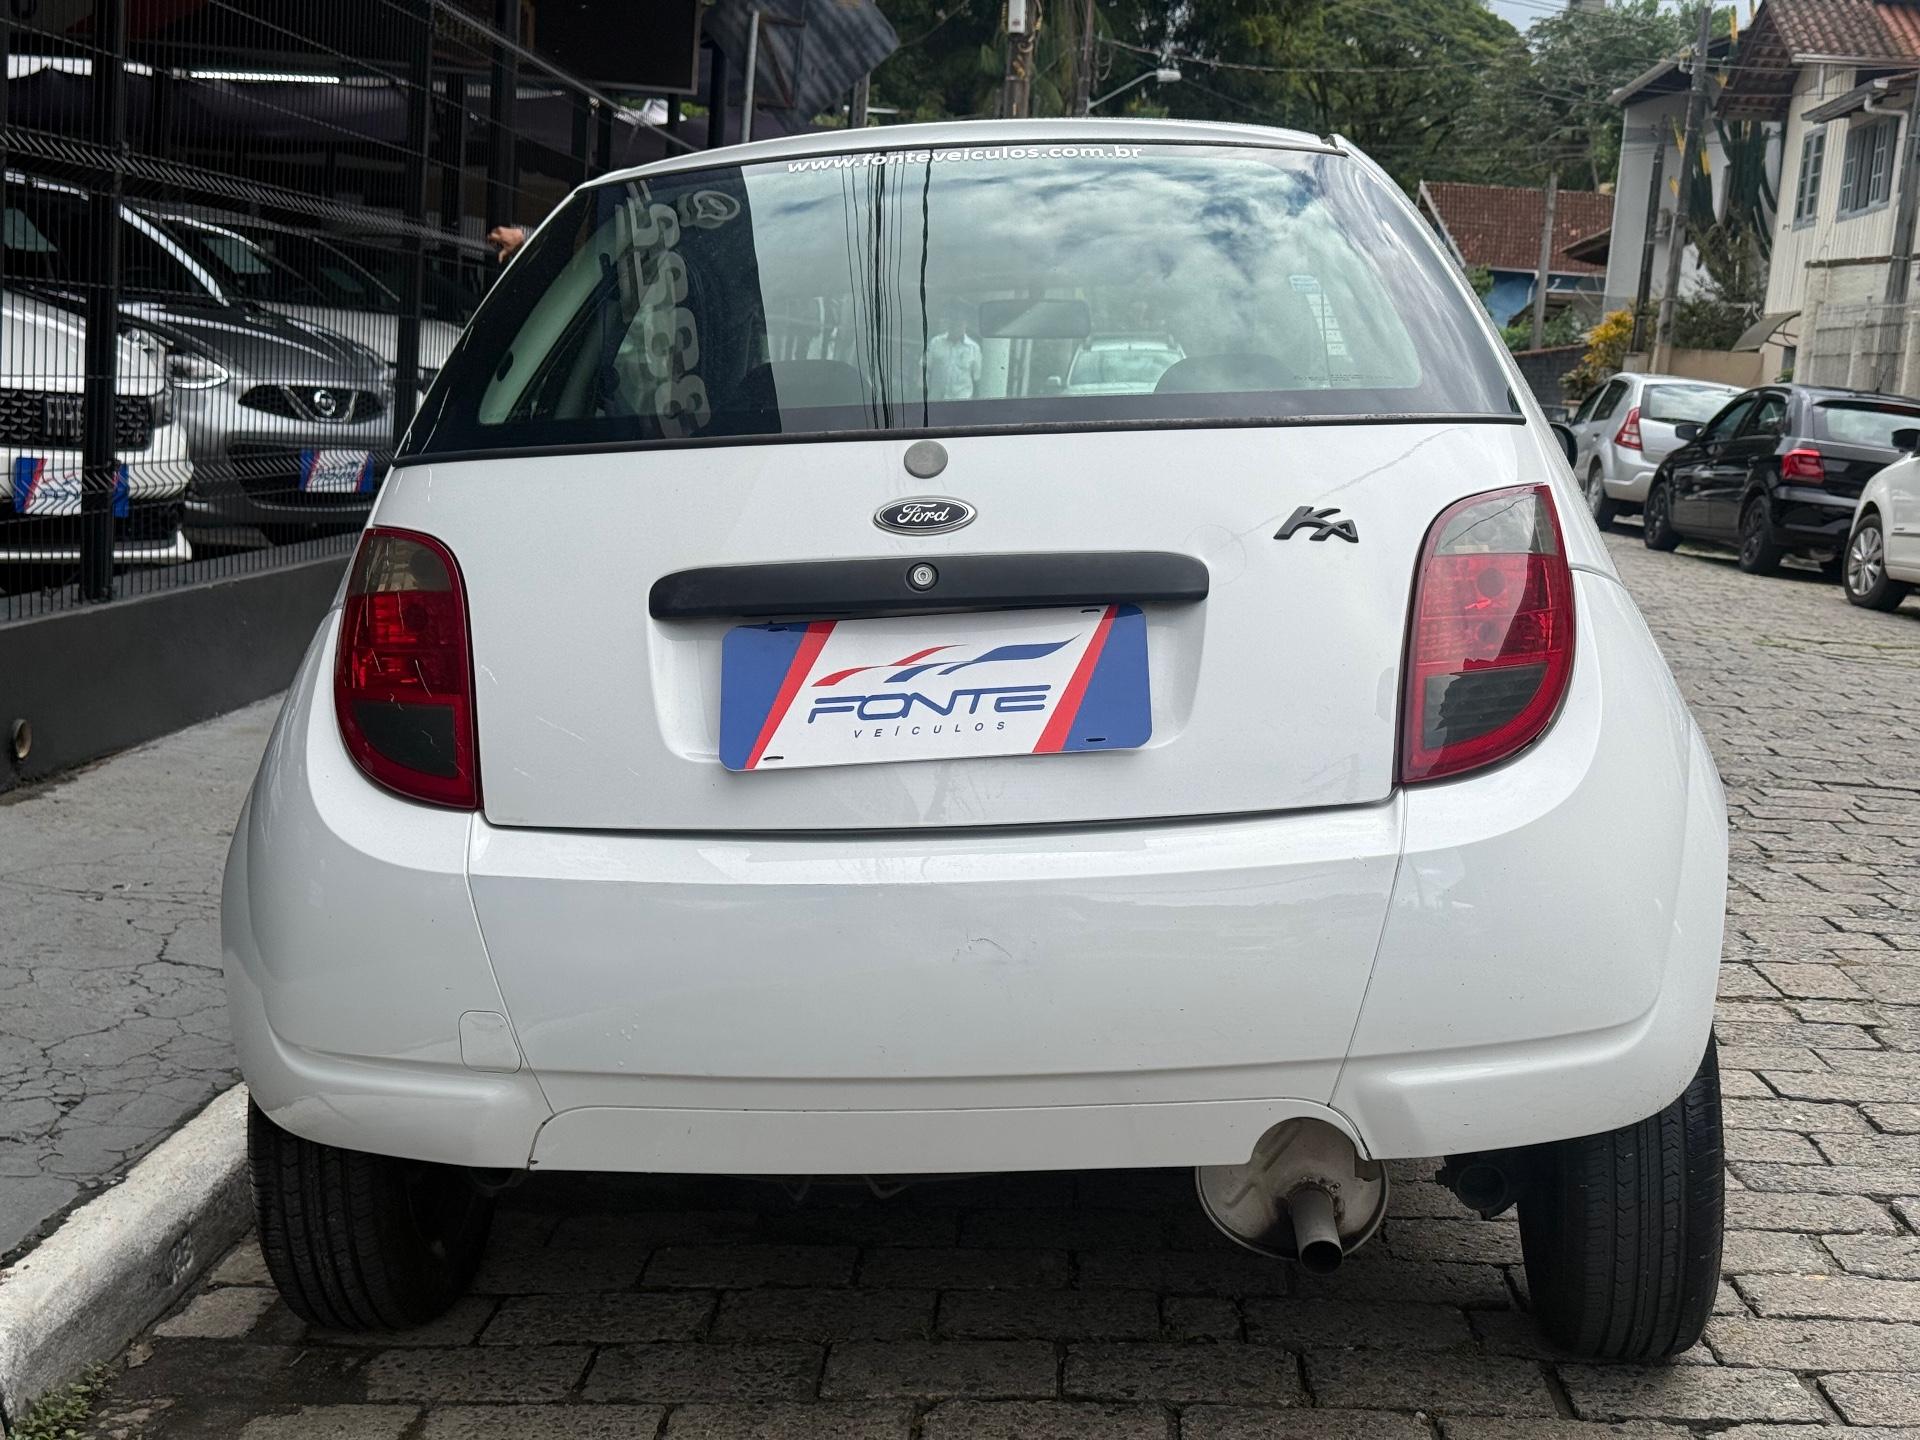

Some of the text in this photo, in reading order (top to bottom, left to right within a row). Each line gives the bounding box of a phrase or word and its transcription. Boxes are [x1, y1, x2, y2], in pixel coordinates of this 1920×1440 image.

[787, 145, 1143, 173] www.fonteveiculos.com.br
[897, 503, 950, 523] Ford
[807, 684, 1052, 724] FONTE
[853, 721, 1006, 739] VEÍCULOS
